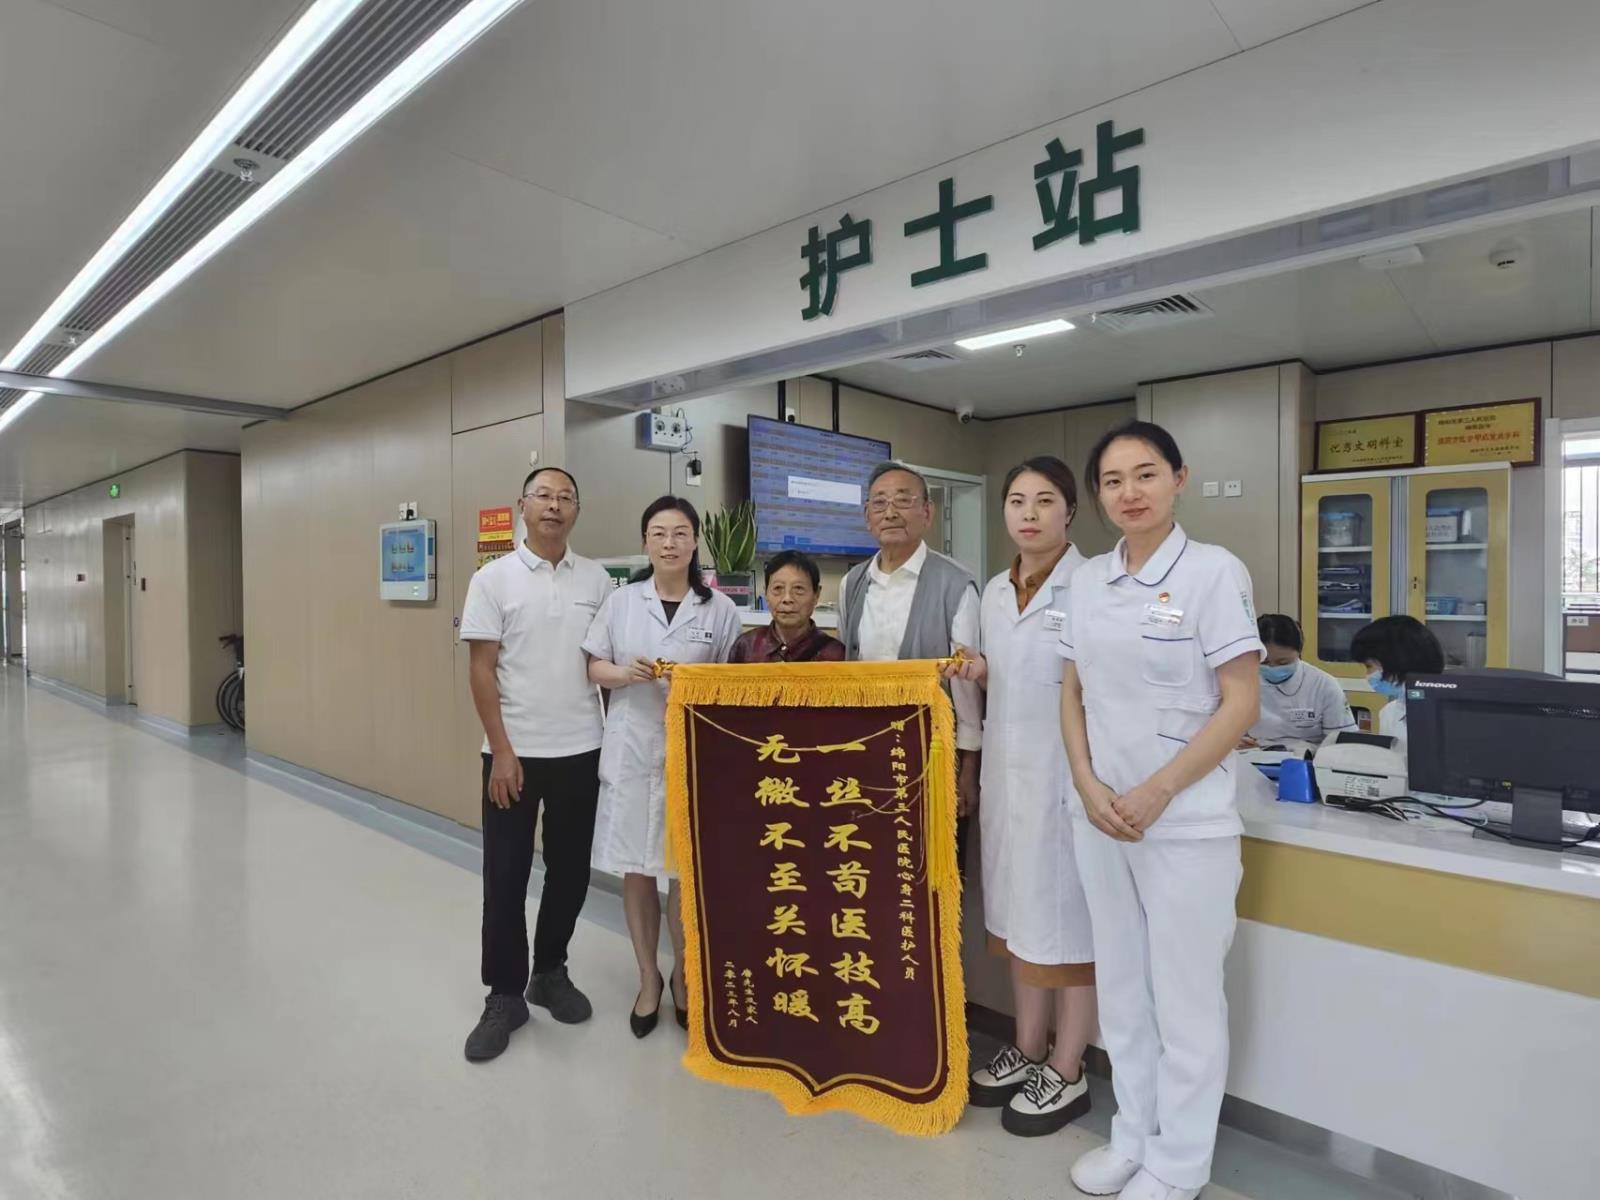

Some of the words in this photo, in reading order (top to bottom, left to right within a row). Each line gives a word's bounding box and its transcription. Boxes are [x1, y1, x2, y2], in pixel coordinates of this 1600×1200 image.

[800, 120, 1144, 321] 护士站
[1415, 680, 1458, 689] lenovo
[754, 733, 820, 1023] 无微不至关怀暖
[816, 741, 881, 1035] 一丝不苟医技高
